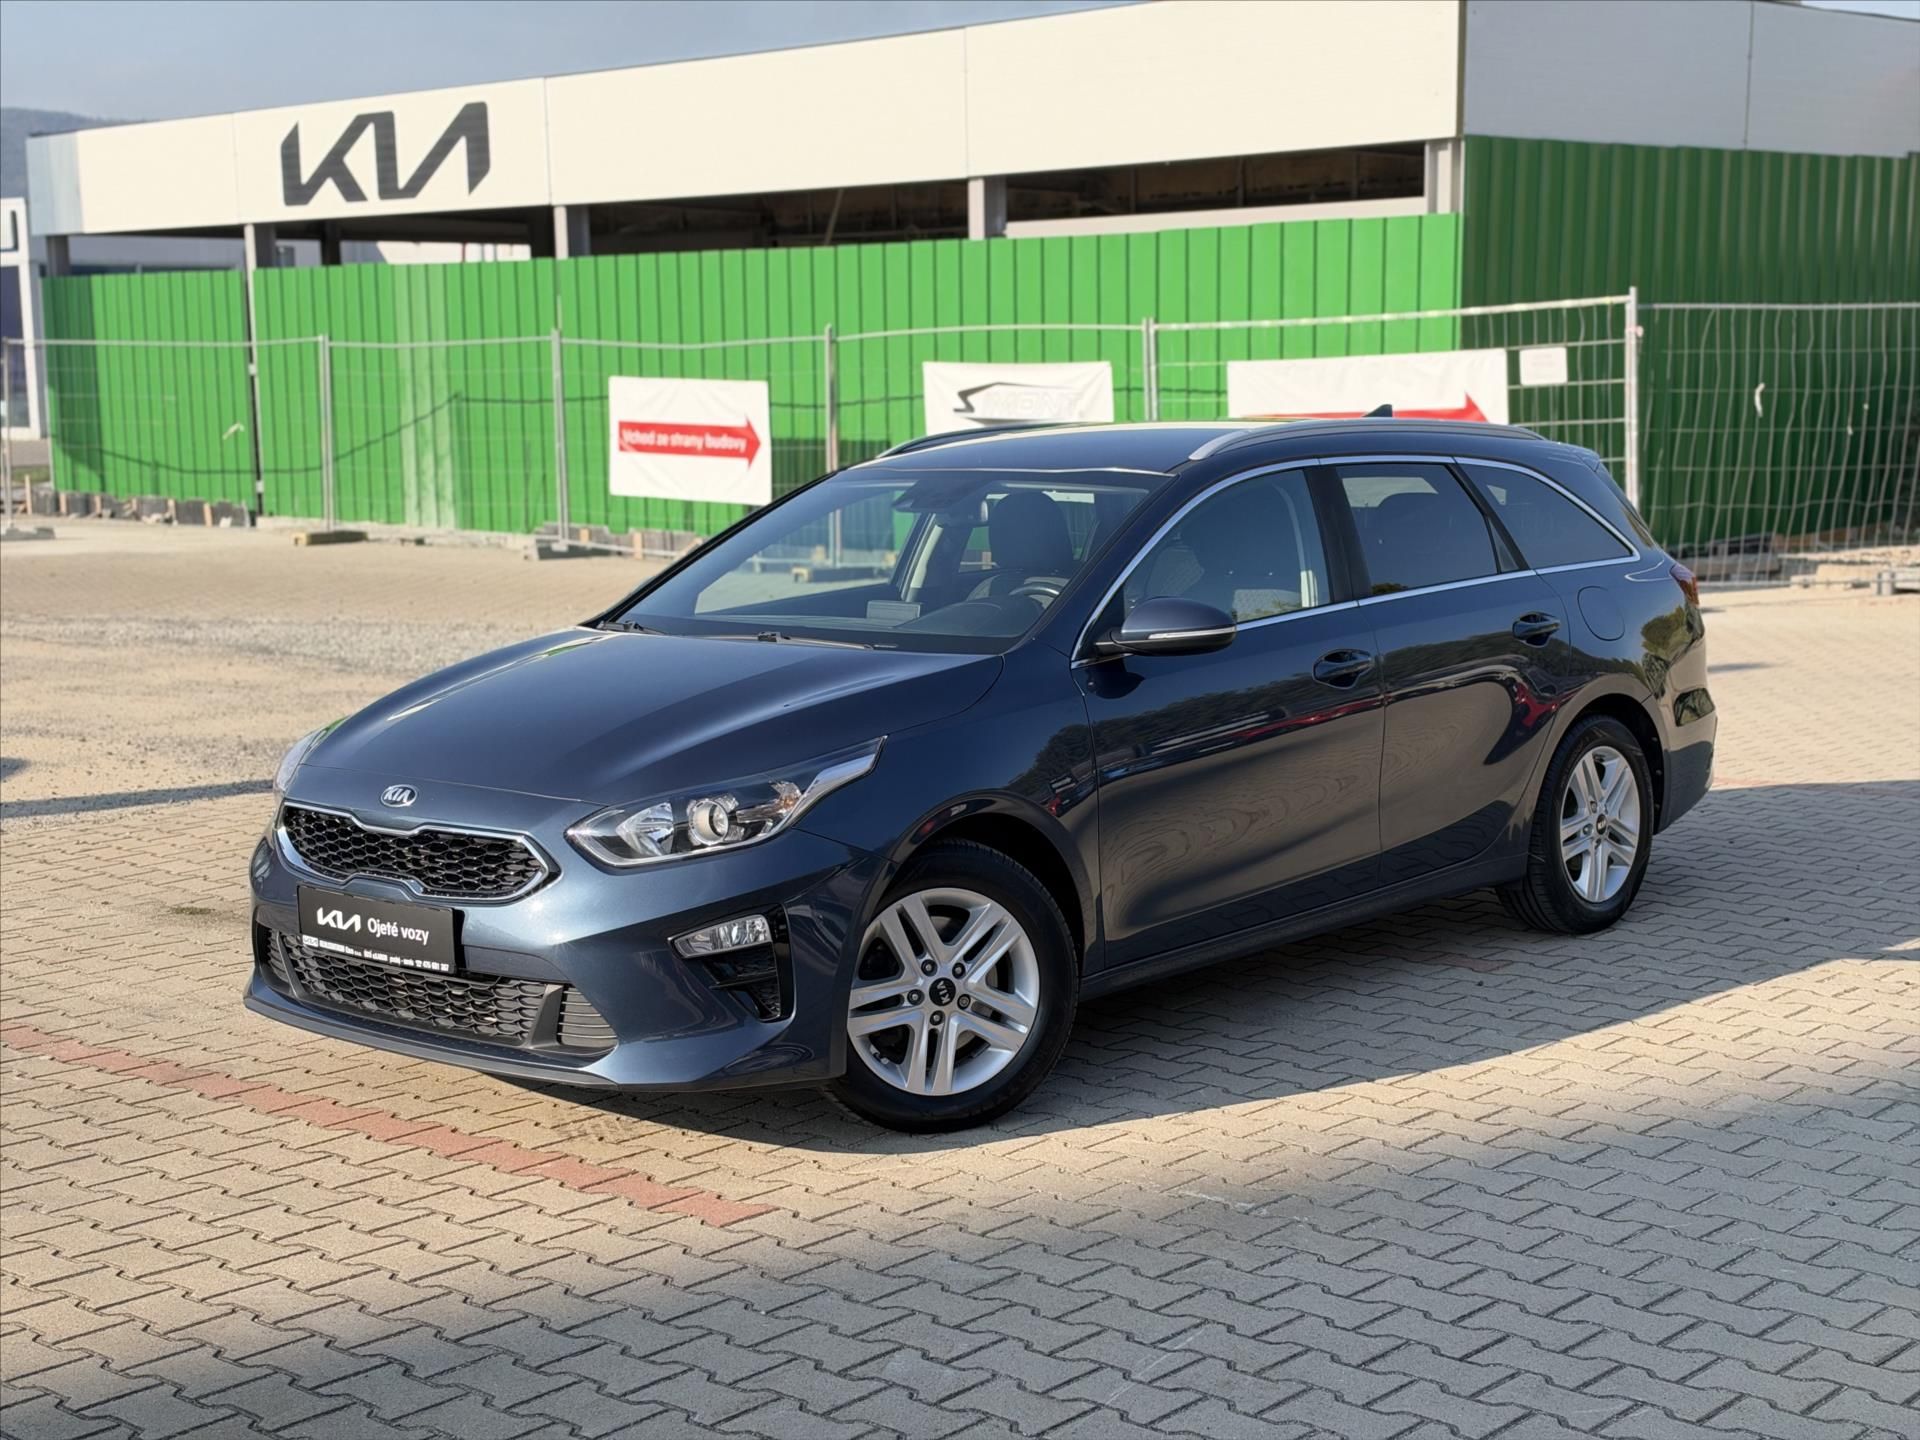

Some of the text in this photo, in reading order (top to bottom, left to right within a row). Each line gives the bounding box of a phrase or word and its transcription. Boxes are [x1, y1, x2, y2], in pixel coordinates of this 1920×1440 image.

[281, 102, 490, 206] KIA
[384, 787, 412, 803] KIA
[316, 907, 429, 946] KIA Ojeté vozy
[937, 981, 950, 1004] KIA
